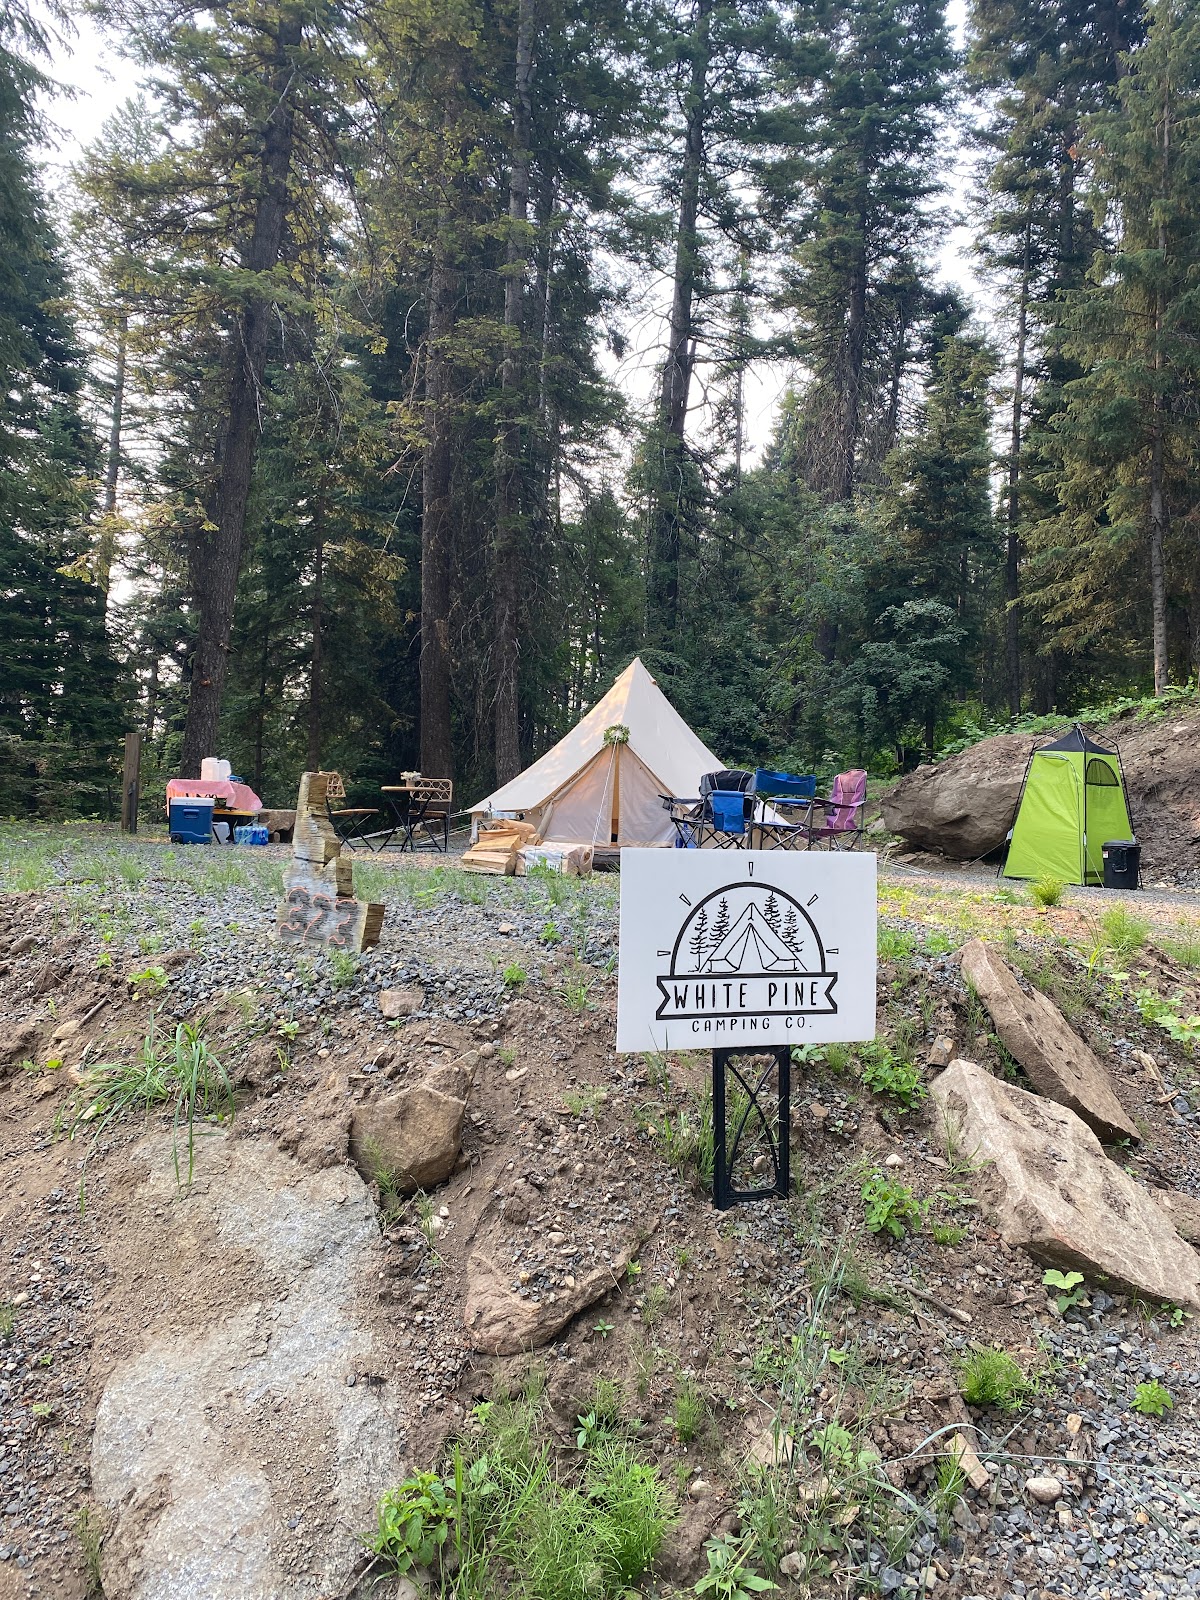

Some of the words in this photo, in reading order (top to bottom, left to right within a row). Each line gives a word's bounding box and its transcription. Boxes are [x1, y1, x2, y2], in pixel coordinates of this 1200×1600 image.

[279, 887, 358, 945] 323
[674, 984, 748, 1009] WHITE
[769, 982, 819, 1006] PINE
[692, 1017, 770, 1032] CAMPING
[785, 1016, 812, 1028] CO.
